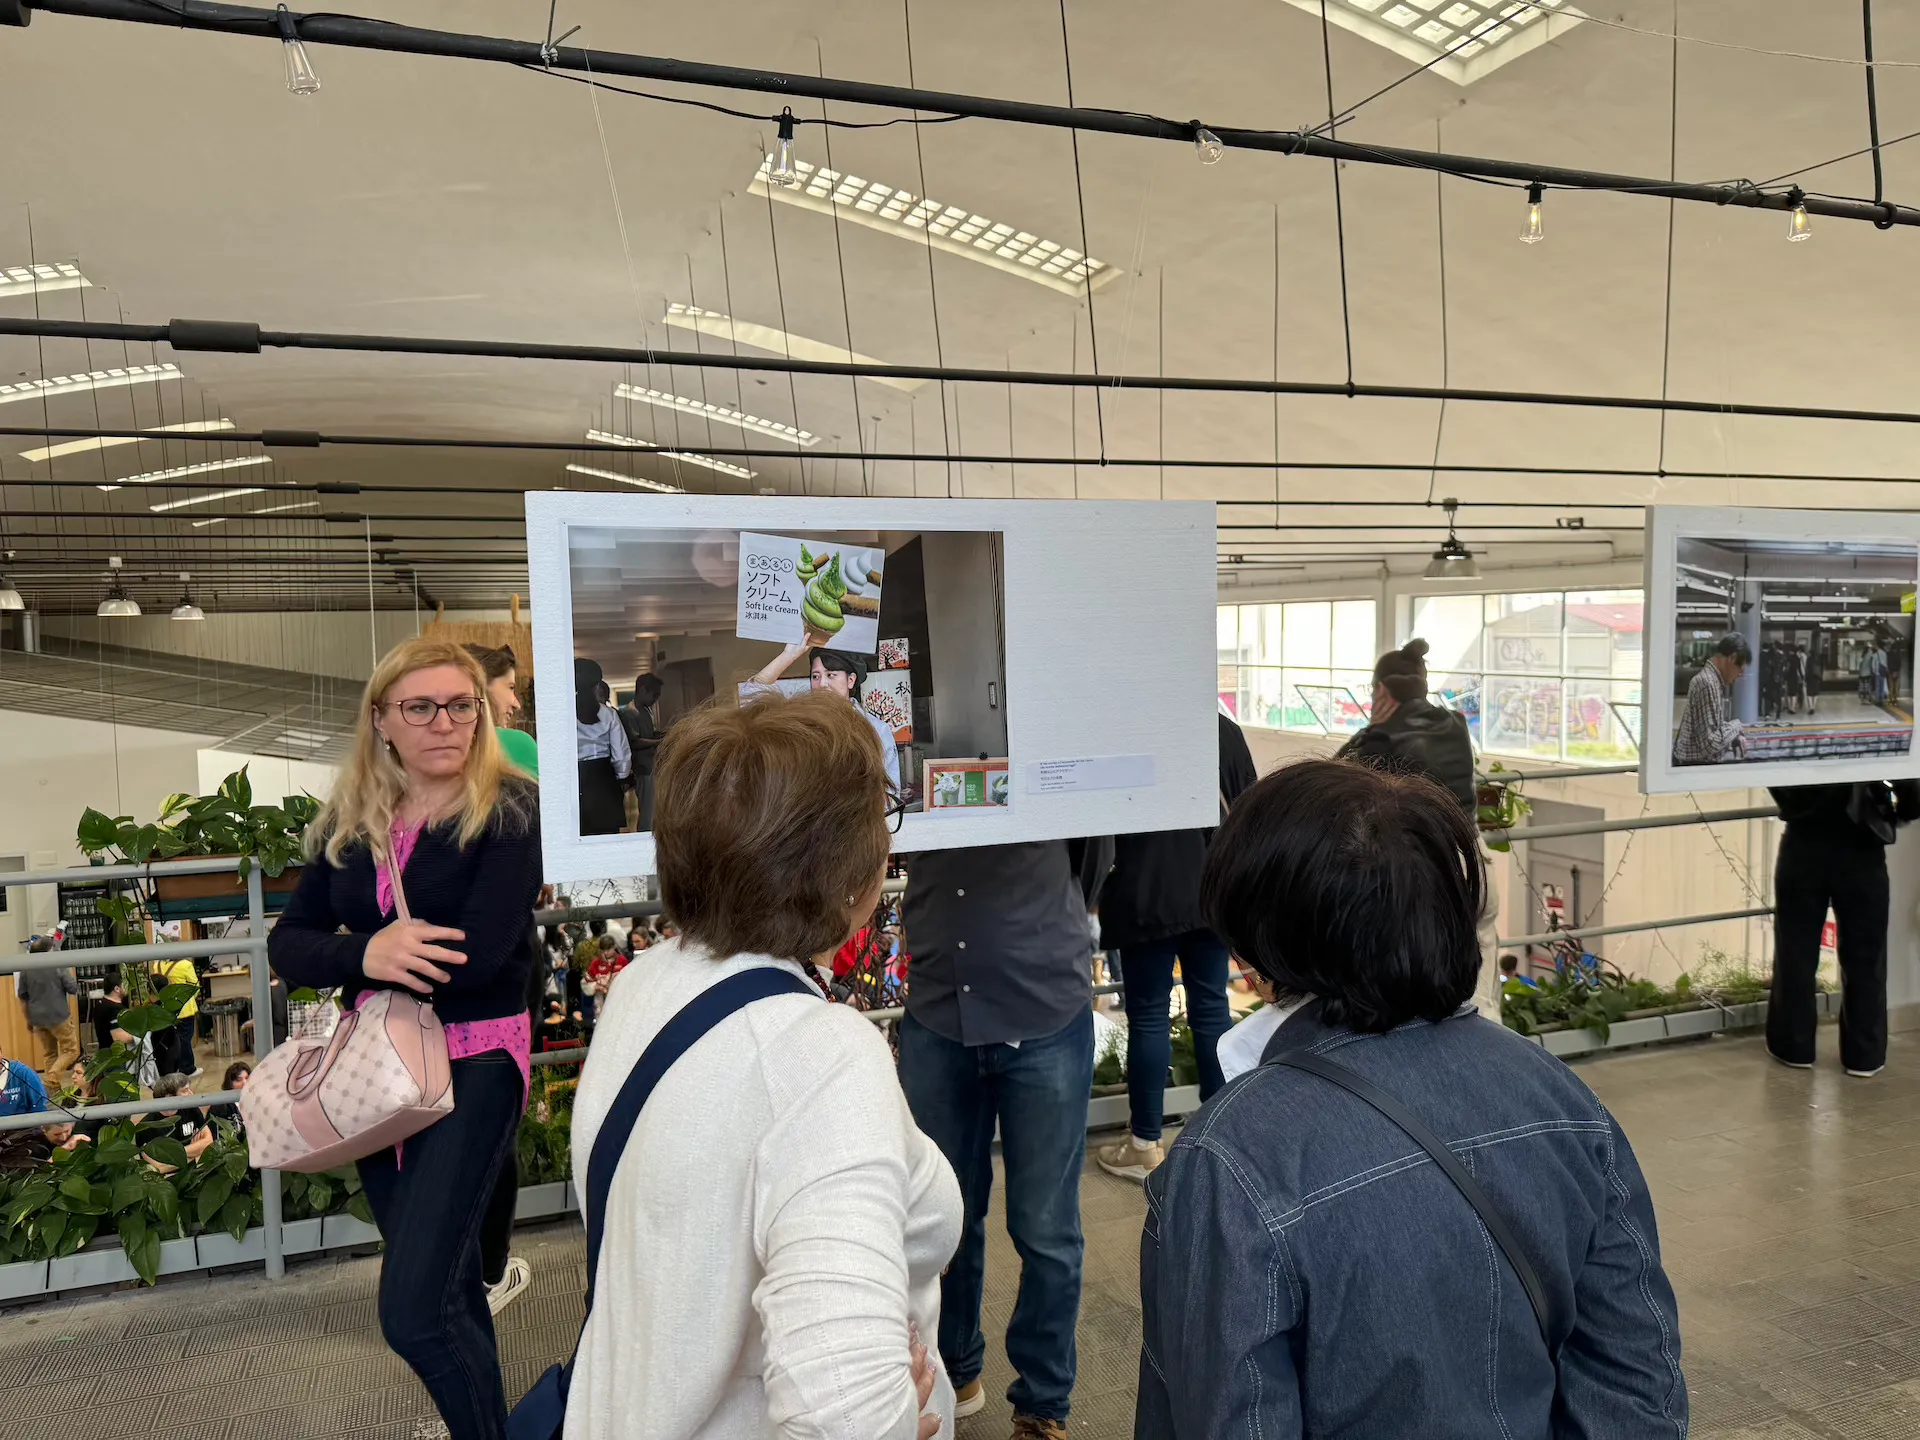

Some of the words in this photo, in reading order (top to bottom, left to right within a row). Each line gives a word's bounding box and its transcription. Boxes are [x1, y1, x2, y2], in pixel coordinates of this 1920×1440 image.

[747, 571, 780, 587] ソフト
[746, 585, 792, 603] クリーム
[745, 600, 760, 610] Soft
[762, 603, 773, 612] Ice
[774, 604, 799, 615] Cream
[895, 681, 911, 697] 秋
